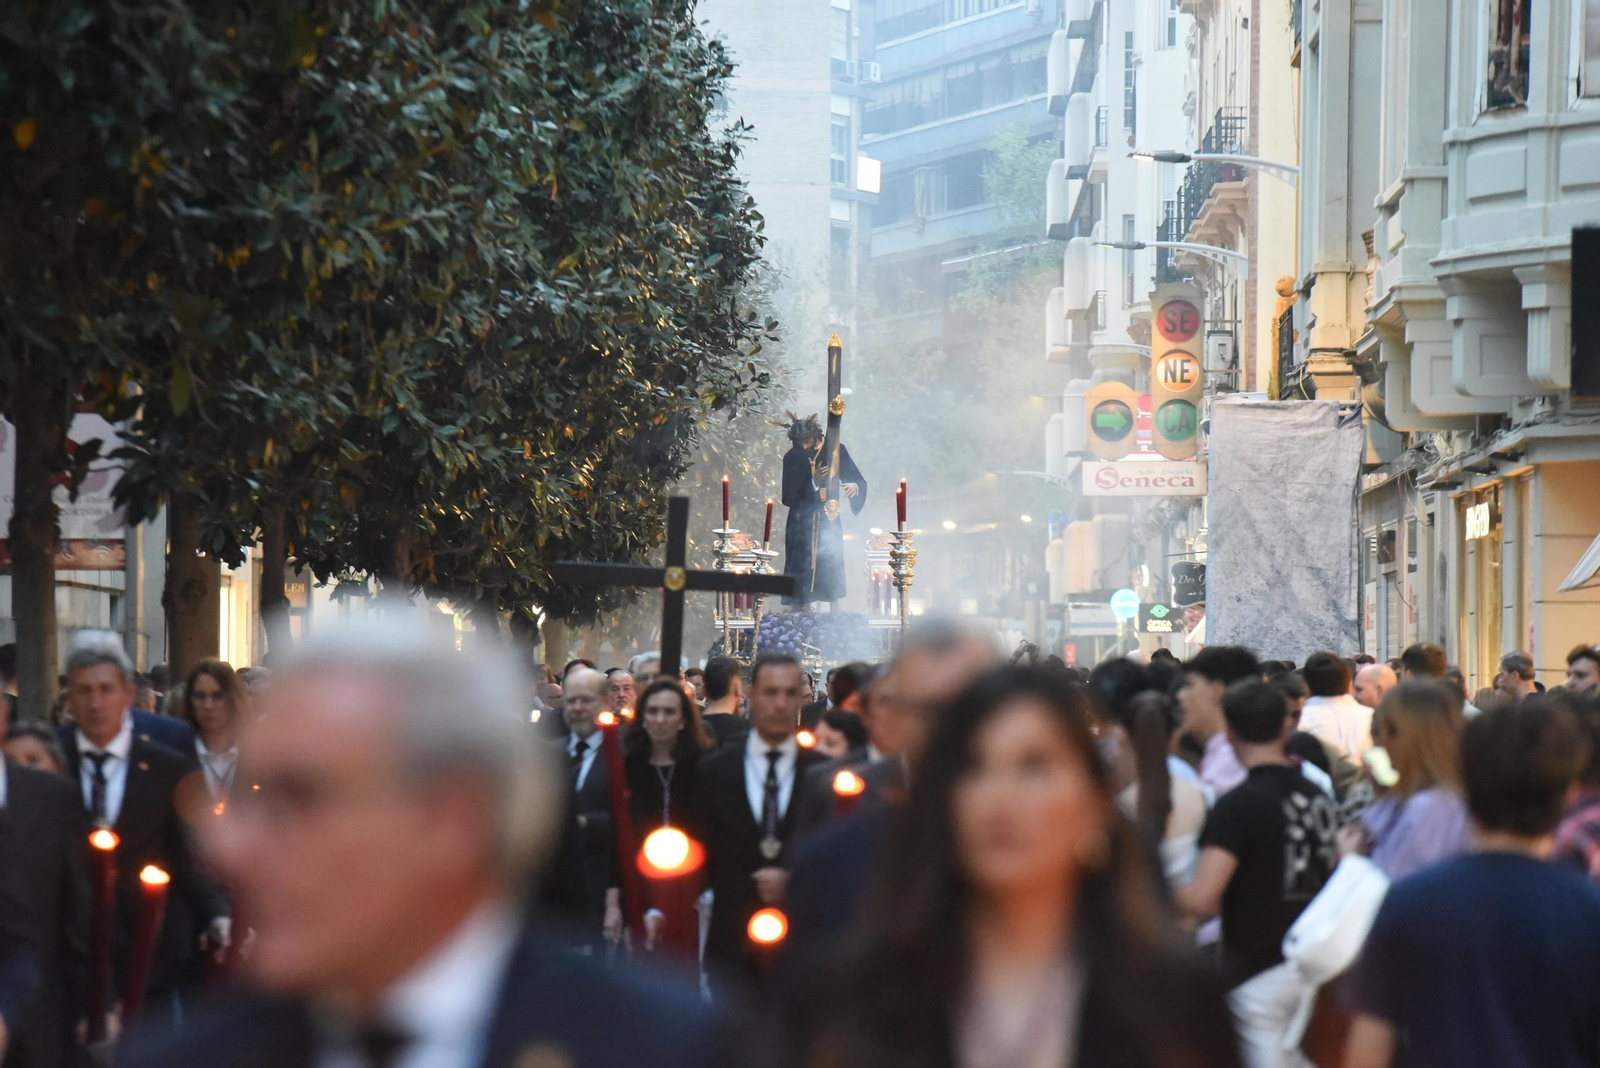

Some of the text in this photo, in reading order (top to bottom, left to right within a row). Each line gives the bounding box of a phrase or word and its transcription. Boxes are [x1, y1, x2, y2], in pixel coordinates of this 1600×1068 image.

[1164, 309, 1192, 334] SE
[1164, 359, 1191, 384] NE
[1163, 408, 1192, 433] CA
[1096, 467, 1195, 489] Seneca
